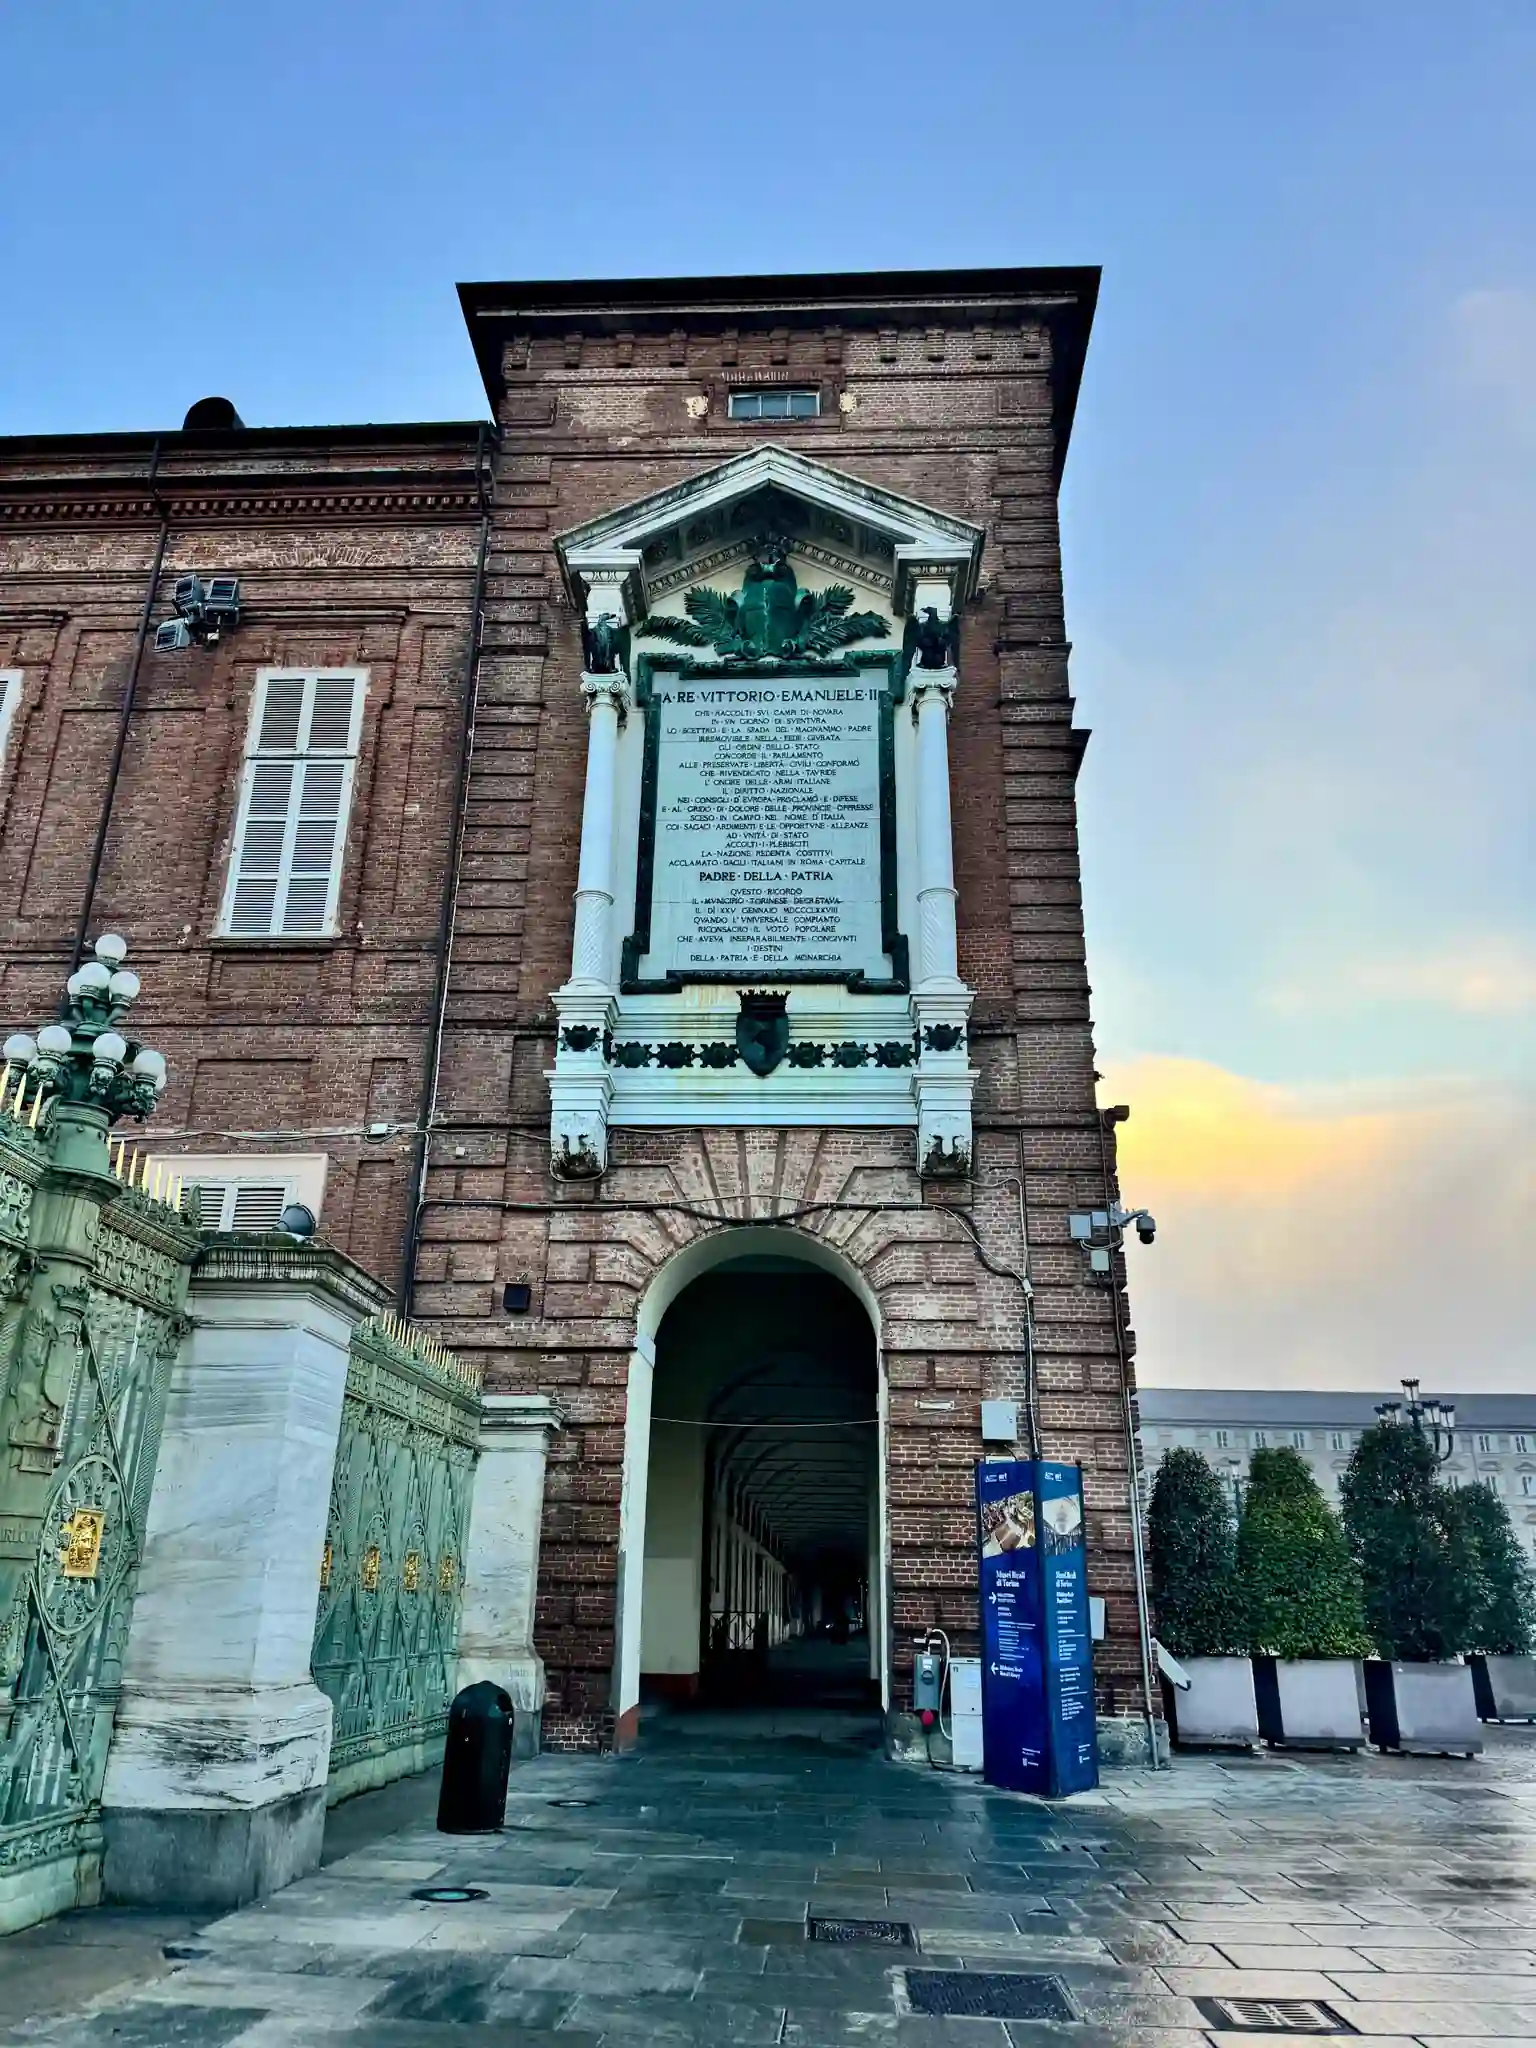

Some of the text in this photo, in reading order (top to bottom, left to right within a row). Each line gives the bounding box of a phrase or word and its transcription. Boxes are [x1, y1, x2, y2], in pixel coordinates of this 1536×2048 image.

[662, 688, 877, 703] A RE VITTORIO EMANUELE II
[756, 709, 769, 717] SVI
[812, 708, 844, 716] NOVARA
[786, 717, 827, 725] SVENTVRA
[666, 727, 678, 735] LO
[746, 726, 770, 734] SPADA
[794, 725, 842, 733] MAGNANIMO
[772, 751, 824, 759] PARLAMENTO
[678, 761, 698, 769] ALLE
[702, 761, 749, 769] PRESERVATE
[719, 769, 771, 777] RIVENDICATO
[775, 769, 800, 777] NELLA
[694, 796, 730, 804] CONSIGLI
[832, 795, 859, 803] DIFESE
[671, 805, 682, 813] AL
[686, 805, 712, 813] GRIDO
[689, 814, 715, 822] SCESO
[784, 813, 808, 821] NOME
[683, 823, 711, 831] SAGACI
[779, 822, 826, 830] OPPORTVNE
[830, 821, 869, 829] ALLEANZE
[770, 831, 779, 839] DI
[783, 831, 809, 839] STATO
[701, 850, 713, 858] LA
[755, 849, 791, 857] REDENTA
[668, 859, 719, 867] ACCLAMATO
[800, 858, 824, 866] ROMA
[828, 858, 866, 866] CAPITALE
[699, 871, 834, 882] PADRE DELLA PATRIA
[730, 887, 803, 896] QVESTO RICORDO
[703, 897, 745, 905] MVNICIPIO
[749, 897, 789, 905] TORINESE
[793, 897, 841, 905] DECRETAVA
[693, 916, 728, 924] QVANDO
[793, 915, 841, 923] COMPIANTO
[766, 925, 790, 933] VOTO
[794, 925, 837, 933] POPOLARE
[676, 935, 694, 943] CHE
[697, 935, 724, 943] AVEVA
[753, 944, 783, 952] DESTINI
[690, 954, 715, 962] DELLA
[720, 954, 749, 962] PATRIA
[763, 954, 789, 962] DELLA
